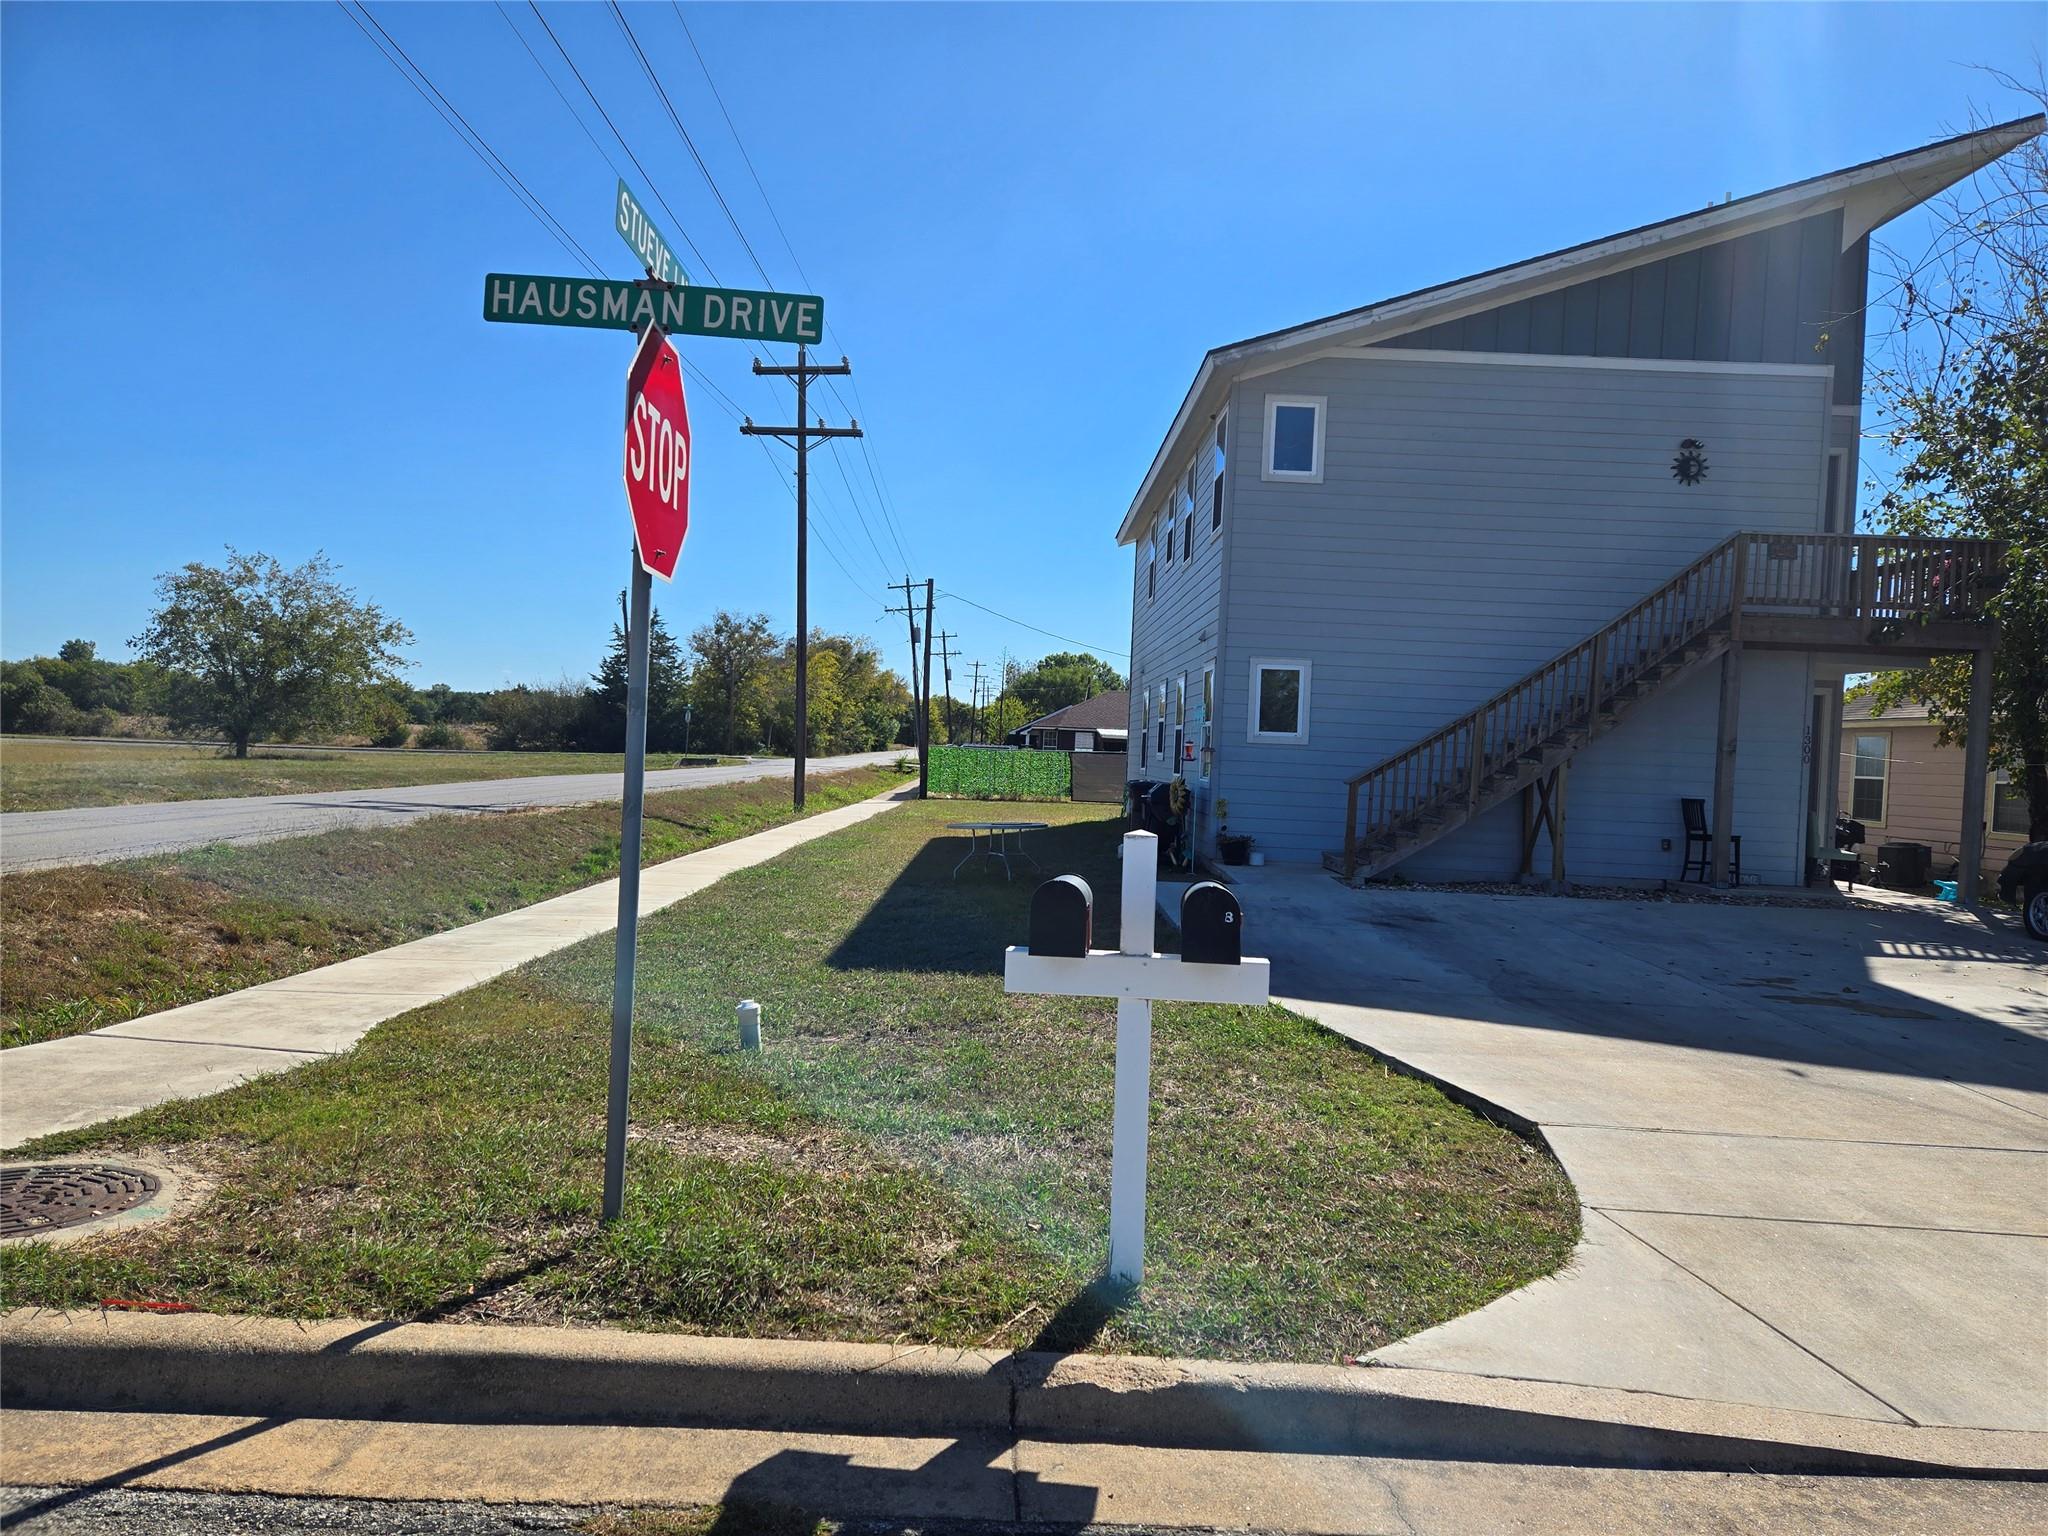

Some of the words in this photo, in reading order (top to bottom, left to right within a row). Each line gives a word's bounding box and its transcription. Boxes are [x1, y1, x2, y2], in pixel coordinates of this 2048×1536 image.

[620, 191, 671, 282] STUEVE
[493, 279, 685, 326] HAUSMAN
[703, 295, 818, 337] DRIVE
[630, 391, 688, 510] STOP
[1803, 726, 1811, 764] 1300
